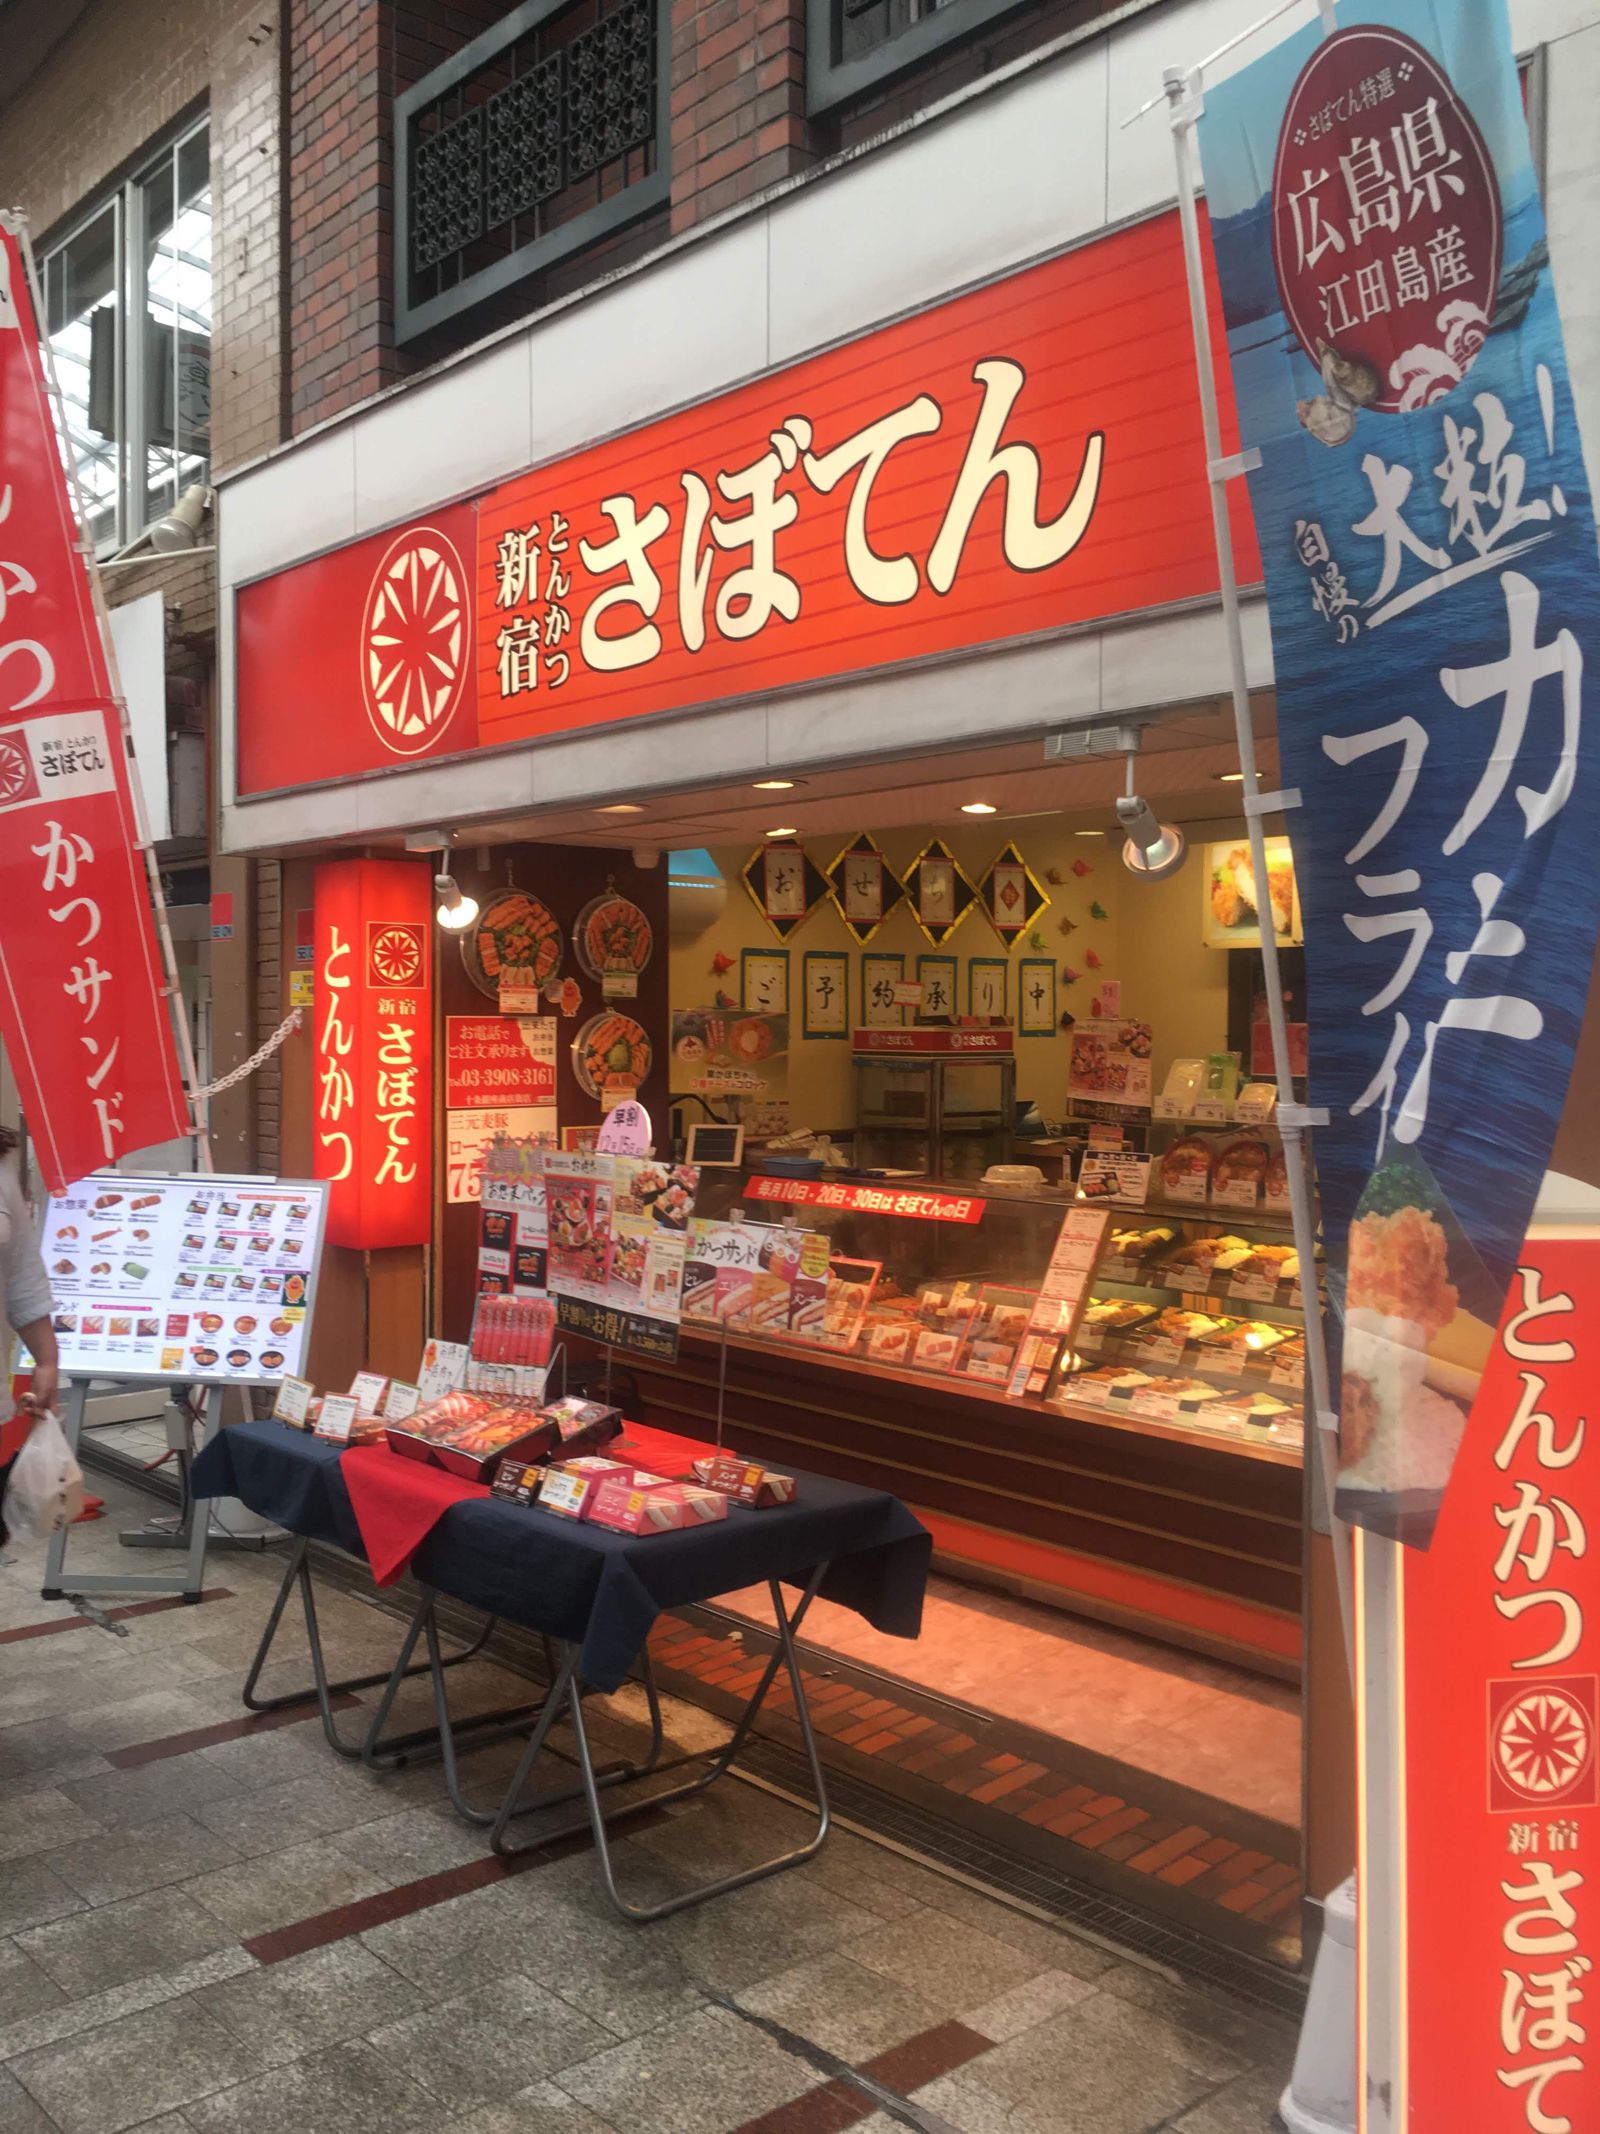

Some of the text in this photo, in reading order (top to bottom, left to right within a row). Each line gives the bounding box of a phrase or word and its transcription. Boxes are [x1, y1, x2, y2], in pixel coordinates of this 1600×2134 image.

[1286, 96, 1467, 275] 広島県
[1308, 68, 1397, 143] さぼてん特選
[1317, 224, 1476, 338] 江田島産
[579, 356, 1105, 673] さぼてん
[1294, 520, 1359, 644] 自慢の
[494, 530, 539, 699] 新宿
[544, 512, 571, 689] とんかつ
[40, 748, 105, 777] さぼてん
[31, 820, 124, 1160] かつサンド
[319, 925, 354, 1182] とんかつ
[377, 998, 417, 1016] 新宿
[460, 1025, 510, 1041] お電話で
[374, 1023, 417, 1185] さぼてん
[697, 1237, 759, 1265] かつサンド
[1492, 1266, 1588, 1670] とんかつ
